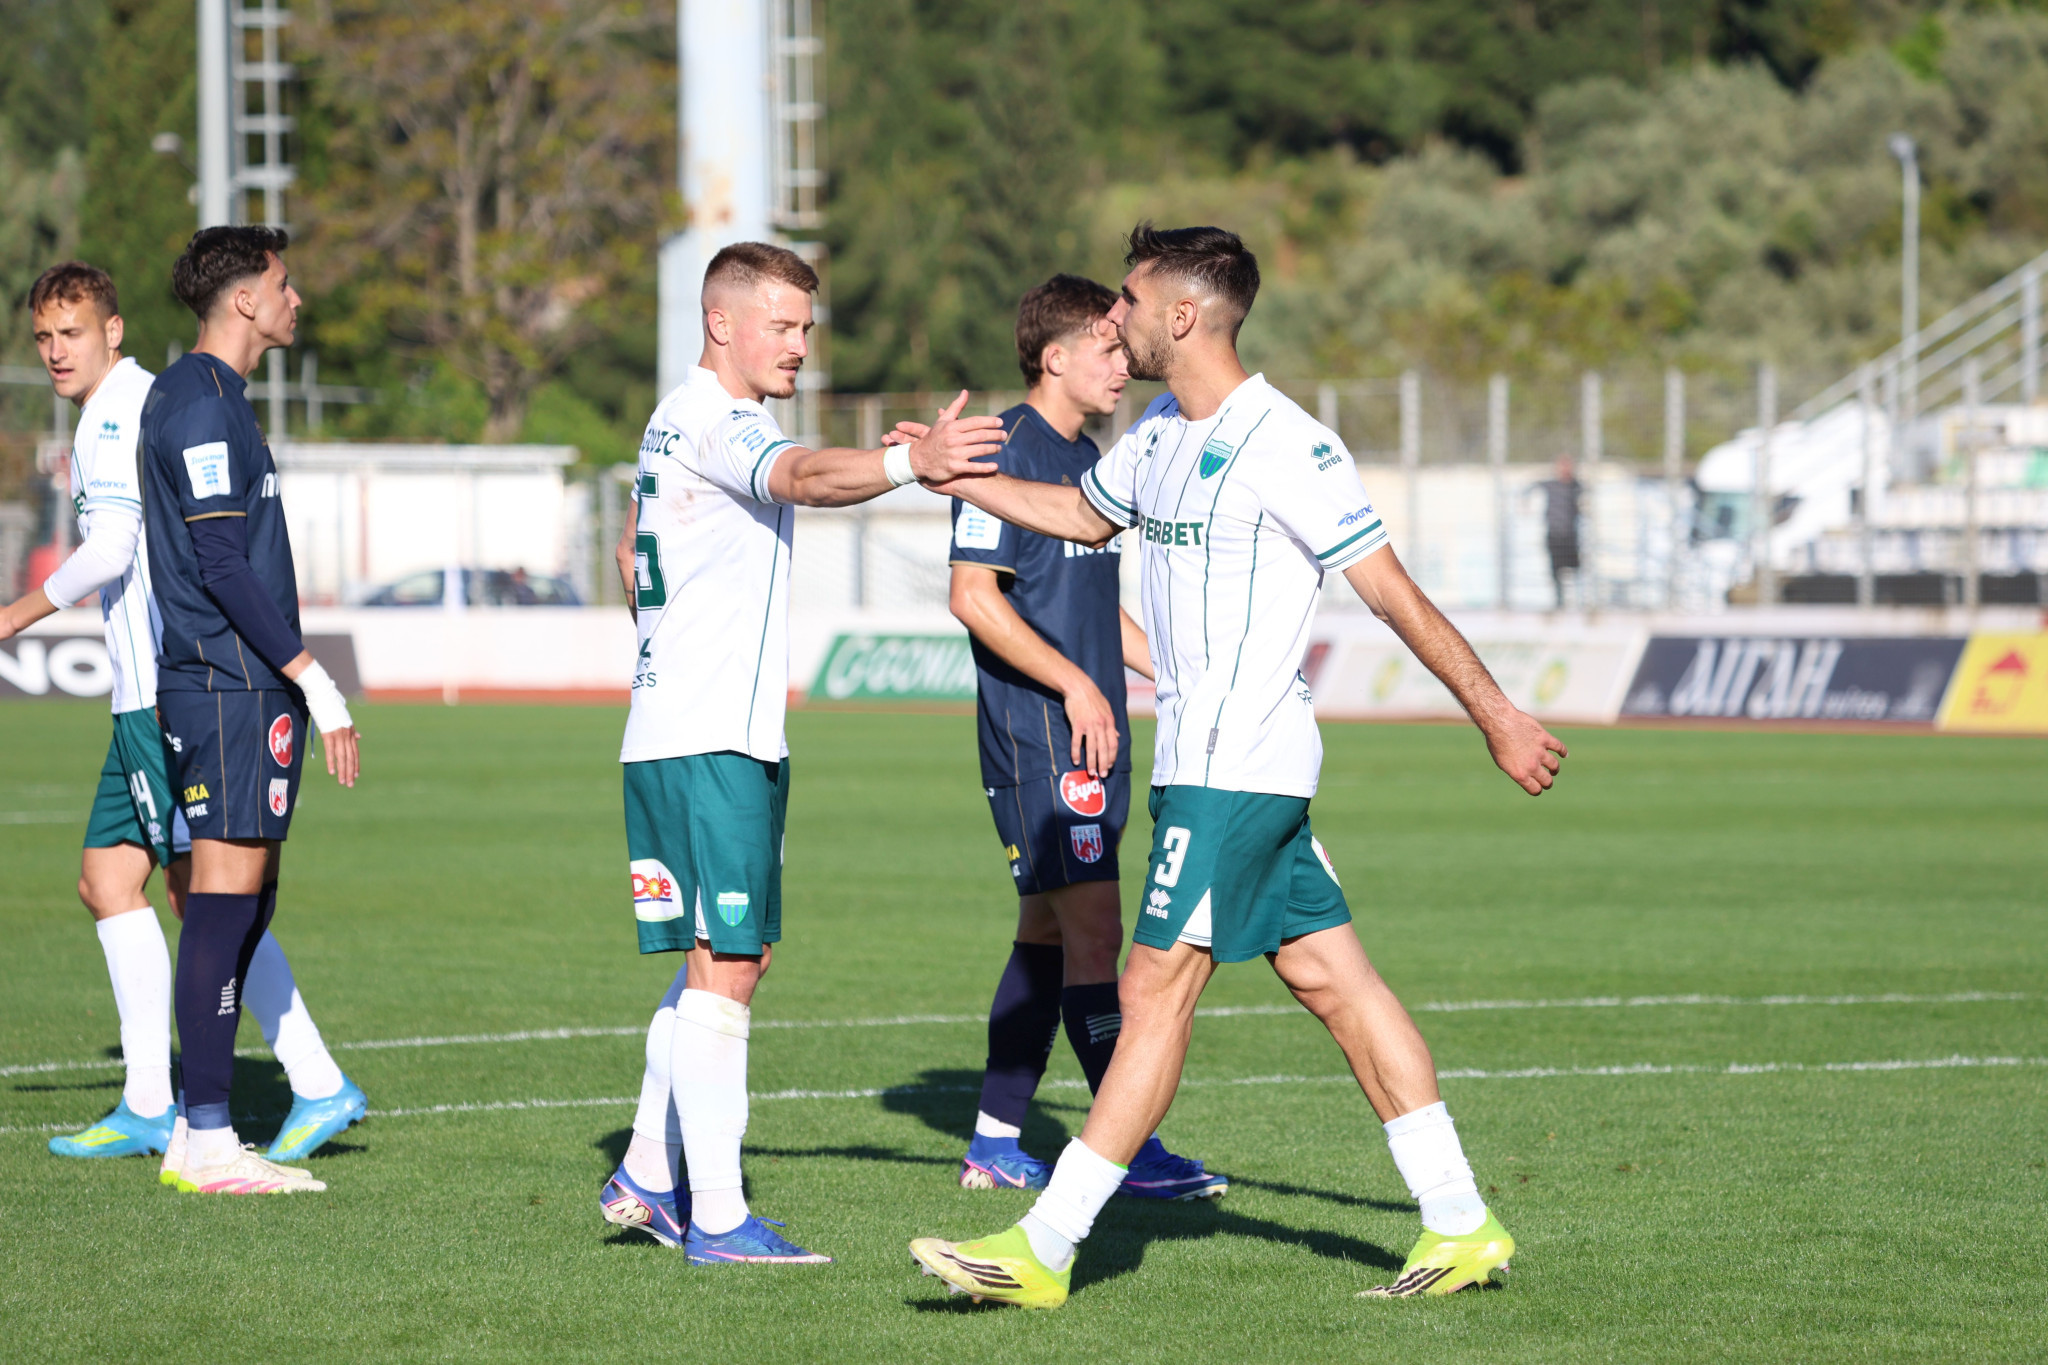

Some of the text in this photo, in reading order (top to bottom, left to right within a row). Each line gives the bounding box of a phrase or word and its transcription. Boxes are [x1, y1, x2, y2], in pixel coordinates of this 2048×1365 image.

[1317, 454, 1343, 472] errea
[1154, 826, 1192, 888] 3
[631, 871, 672, 898] Dole
[1145, 904, 1169, 920] errea
